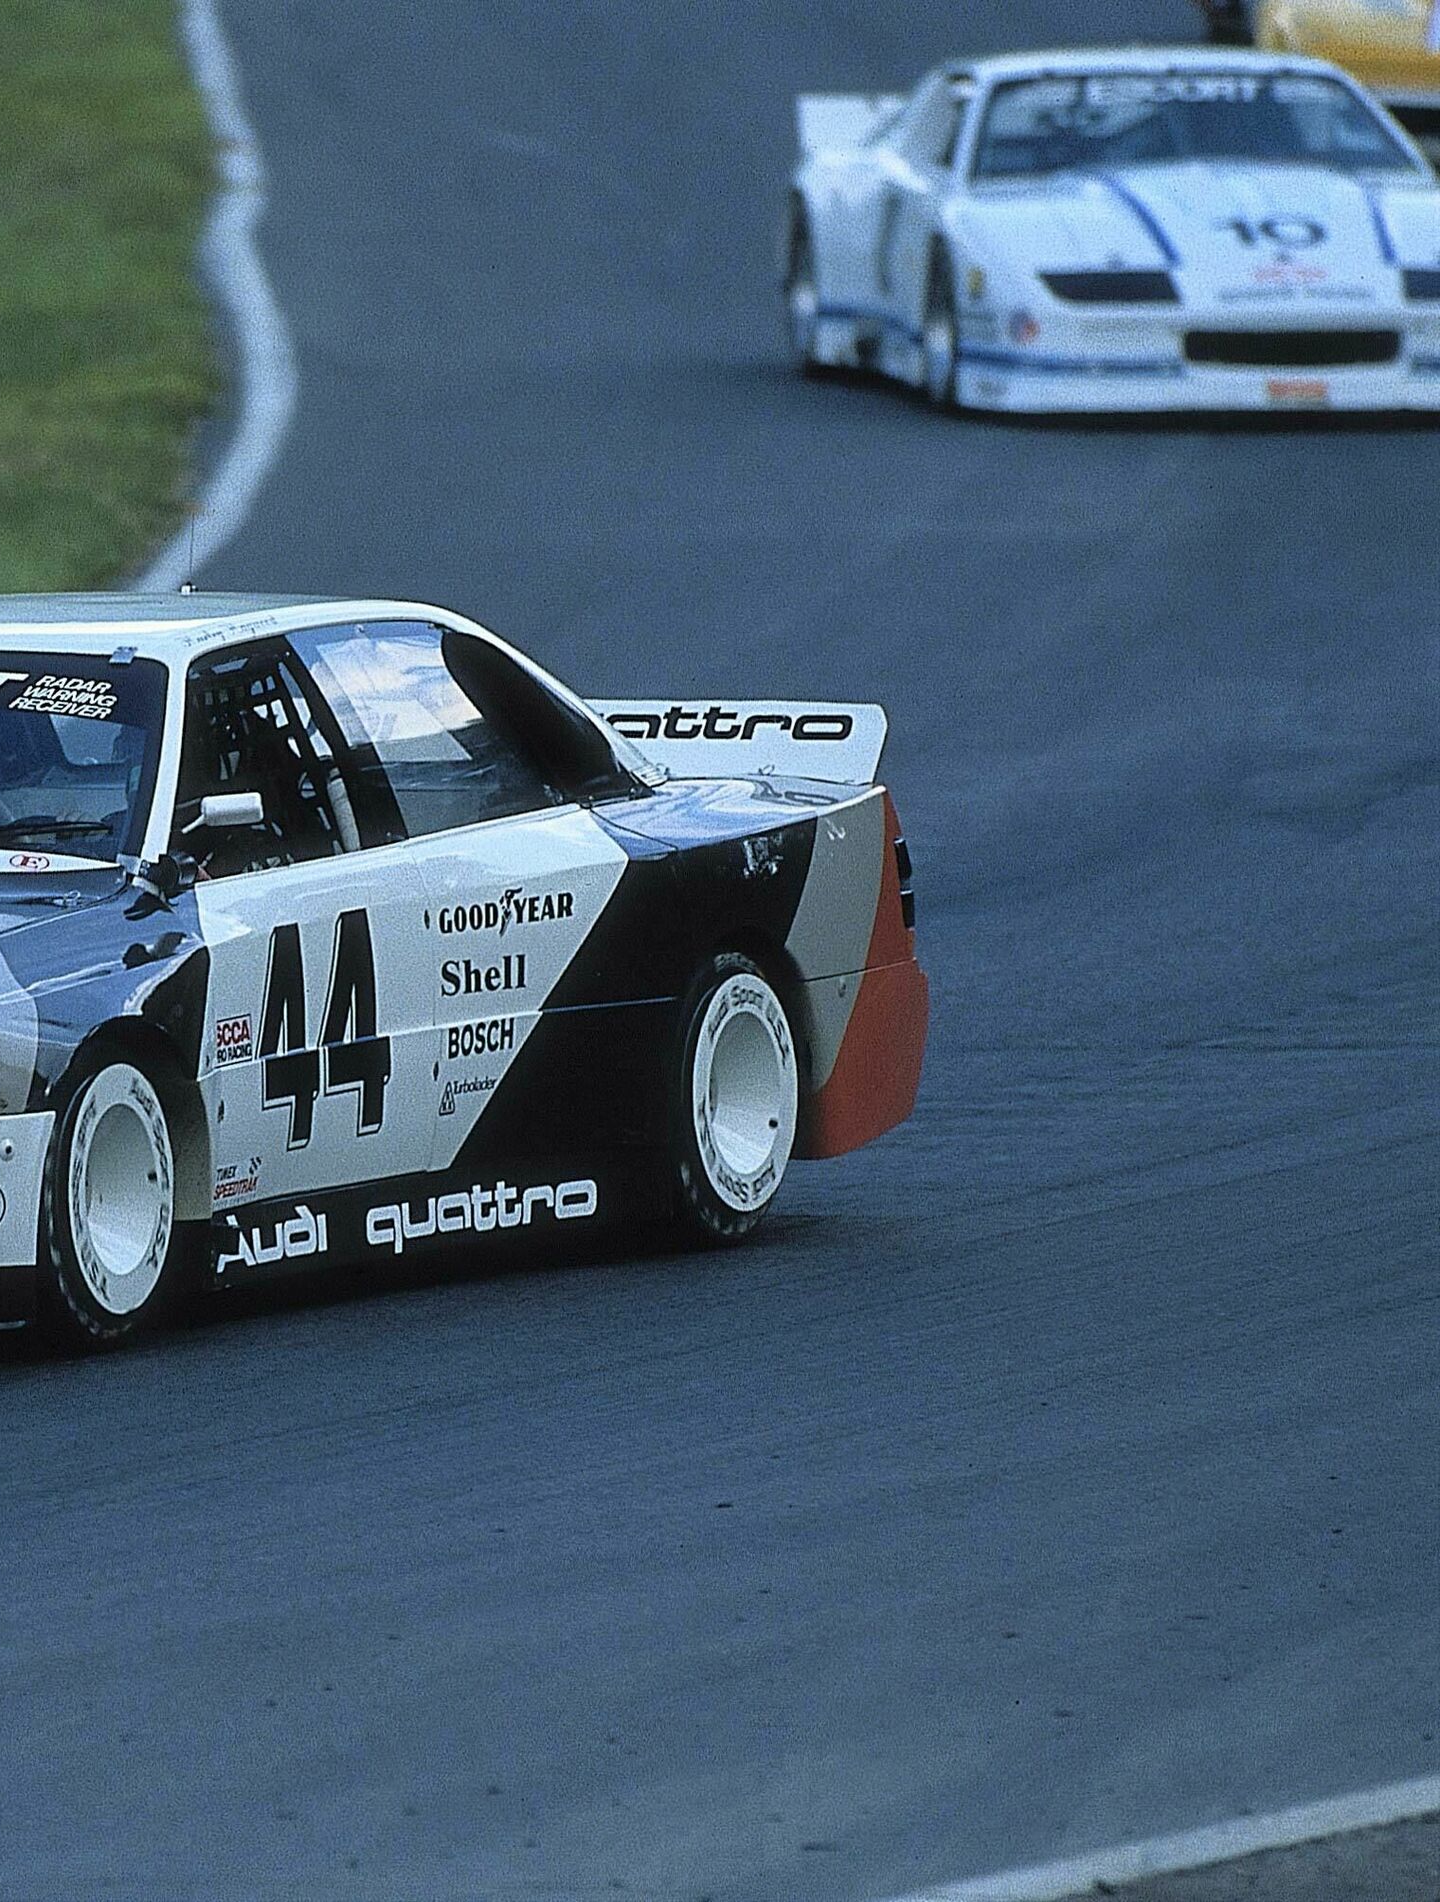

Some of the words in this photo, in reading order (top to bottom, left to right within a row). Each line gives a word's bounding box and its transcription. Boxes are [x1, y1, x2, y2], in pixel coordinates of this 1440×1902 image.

[1216, 214, 1327, 250] 10
[22, 685, 118, 708] WARNING
[35, 675, 113, 694] RADAR
[8, 697, 112, 719] RECEIVER
[599, 706, 854, 741] attro
[440, 954, 527, 997] Shell
[256, 907, 391, 1152] 44
[448, 1017, 515, 1060] BOSCH
[216, 1205, 328, 1273] Audi
[366, 1179, 598, 1254] quattro
